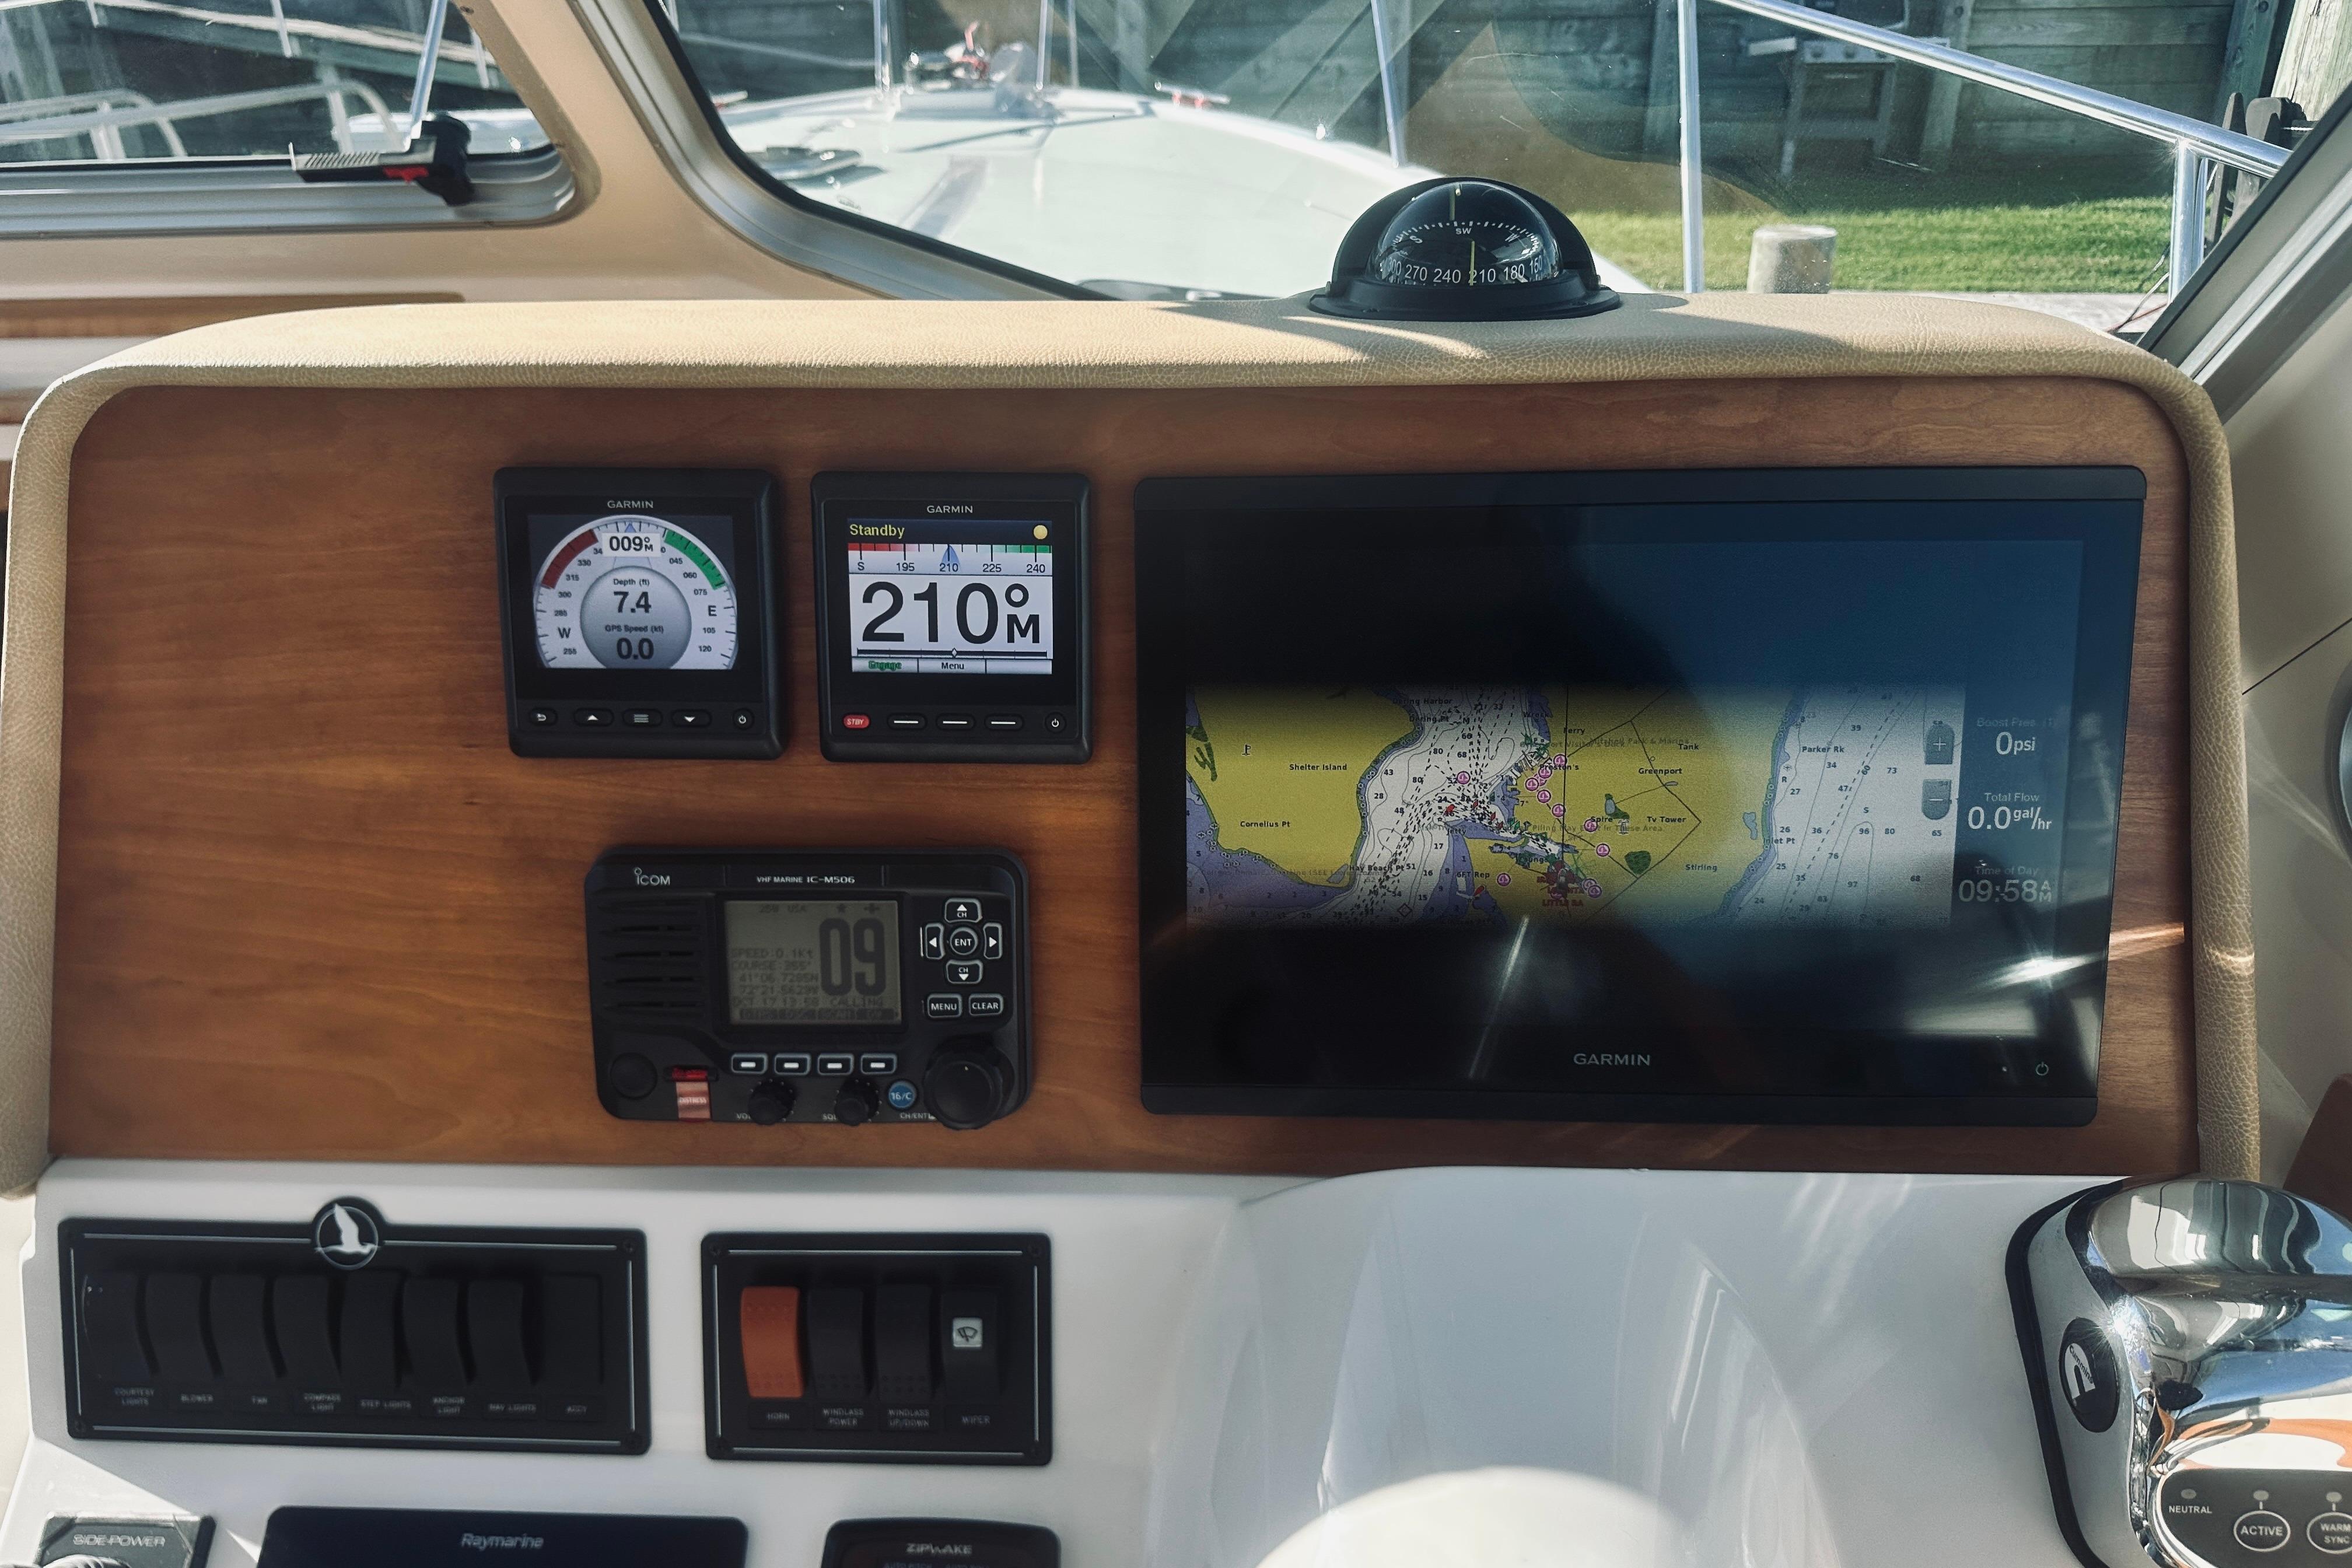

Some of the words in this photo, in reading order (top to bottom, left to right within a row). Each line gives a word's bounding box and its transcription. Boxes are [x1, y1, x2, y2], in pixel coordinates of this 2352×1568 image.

[1405, 264, 1427, 281] 270
[1434, 270, 1461, 284] 240
[1468, 268, 1496, 284] 210
[1503, 264, 1525, 281] 180
[607, 500, 654, 509] GARMIN
[849, 524, 905, 539] Standby
[858, 562, 865, 570] S
[896, 562, 915, 572] 195
[940, 563, 958, 572] 210
[982, 564, 1002, 573] 225
[1026, 564, 1045, 573] 240
[613, 578, 635, 587] Depth
[614, 592, 652, 614] 7.4
[708, 605, 716, 617] E
[558, 627, 571, 638] W
[624, 625, 648, 634] Speed
[617, 638, 654, 660] 0.0
[941, 662, 965, 670] Menu
[846, 718, 864, 726] STBY
[1638, 768, 1682, 776] Greenport
[1984, 792, 2011, 802] Total
[2013, 793, 2040, 803] Flow
[807, 876, 856, 884] IC-M506
[954, 938, 972, 947] ENT
[819, 918, 887, 996] 09
[930, 1003, 957, 1011] MENU
[971, 1002, 999, 1010] CLEAR
[1573, 1054, 1651, 1067] GARMIN
[890, 1091, 912, 1101] 16/C
[2069, 1344, 2094, 1384] Cummins
[766, 1412, 790, 1422] HORN
[822, 1408, 864, 1418] WINDLASS
[888, 1408, 929, 1419] WINDLASS
[961, 1415, 991, 1425] WIPER
[2169, 1505, 2213, 1514] NEUTRAL
[2240, 1525, 2283, 1536] ACTIVE
[2320, 1523, 2351, 1532] WARM
[461, 1532, 544, 1550] Raymarine
[2324, 1535, 2350, 1544] SYNC
